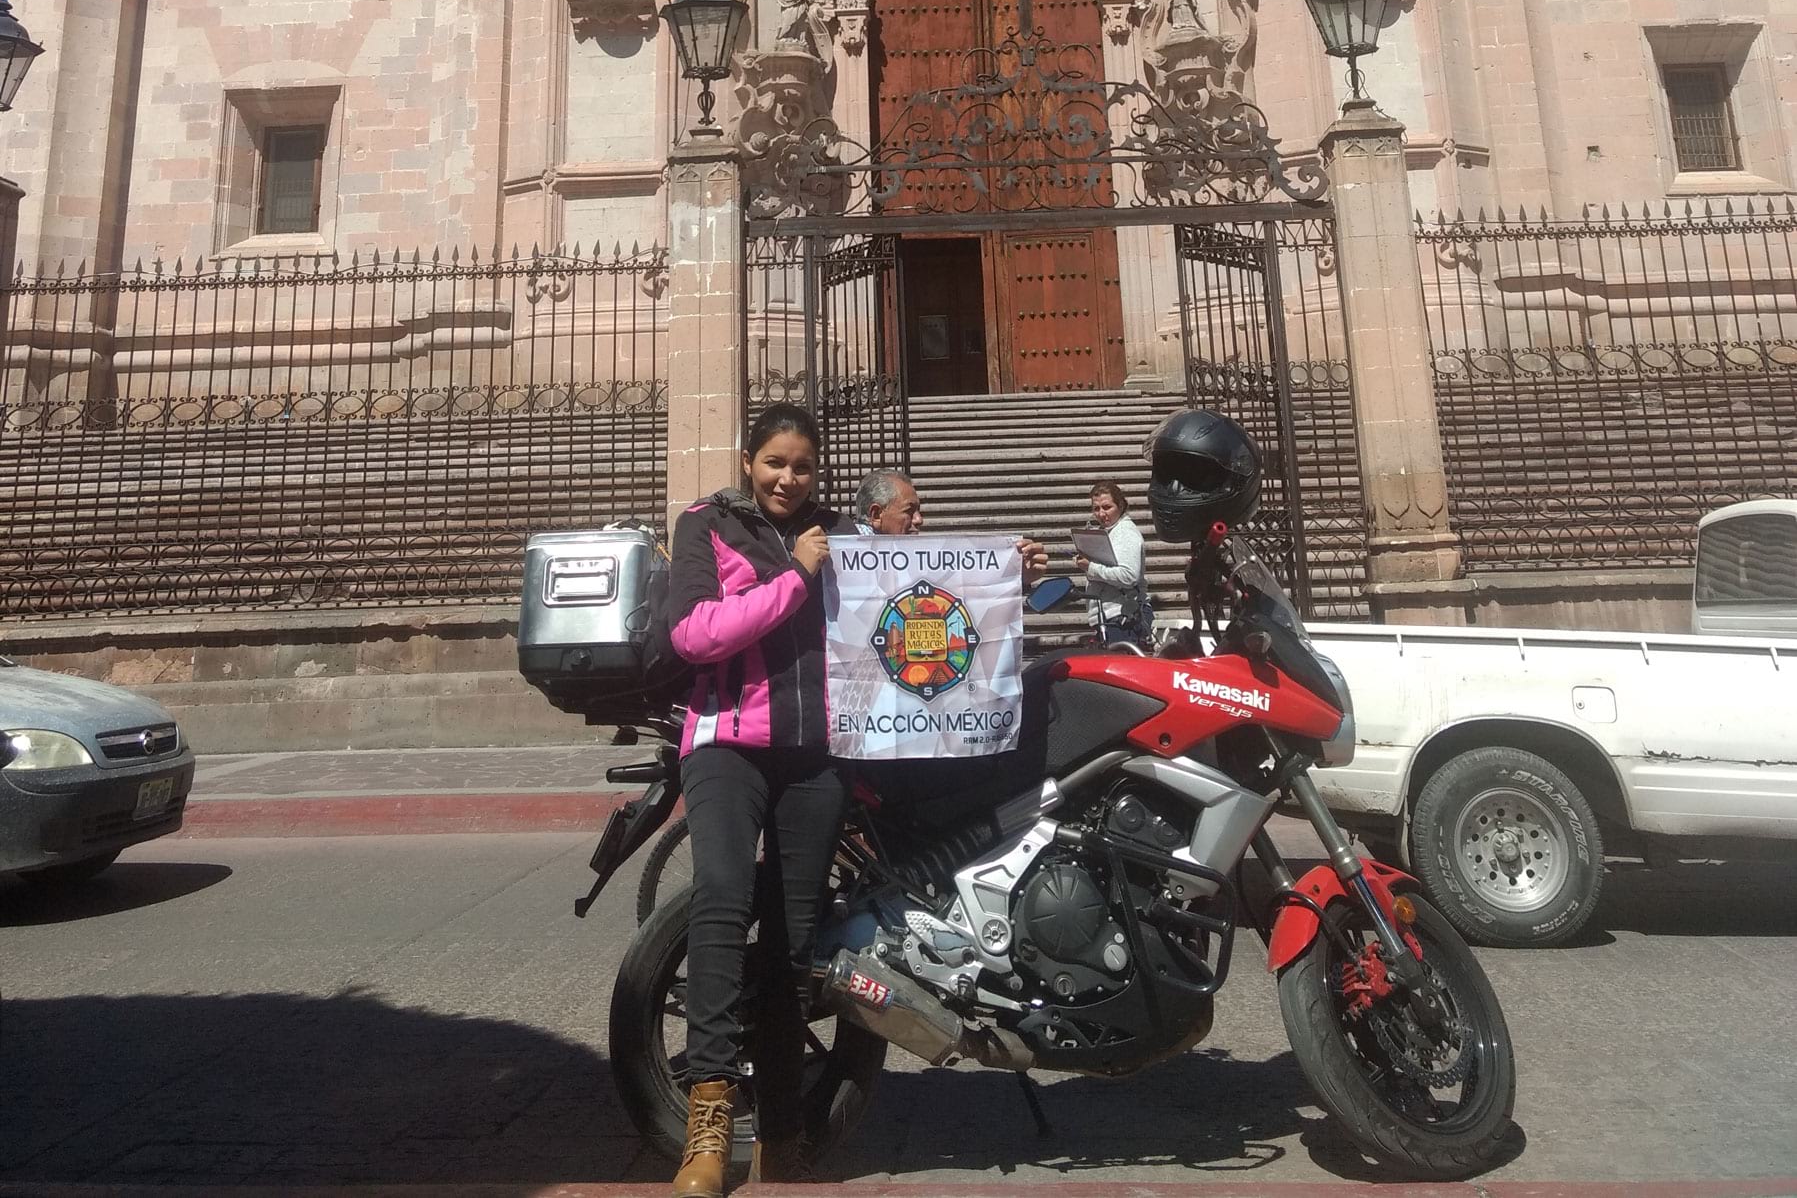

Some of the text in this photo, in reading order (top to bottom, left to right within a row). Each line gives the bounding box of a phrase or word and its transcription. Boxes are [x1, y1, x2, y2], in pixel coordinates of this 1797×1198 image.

[841, 550, 1000, 571] MOTO TURISTA
[918, 586, 929, 595] N
[874, 636, 886, 646] O
[967, 634, 977, 644] E
[923, 687, 934, 696] S
[1173, 671, 1271, 712] Kawasaki
[838, 708, 1014, 734] EN ACCIÓN MÉXICO
[1511, 770, 1590, 865] STARFIRE
[849, 973, 887, 1004] ヨシムラ
